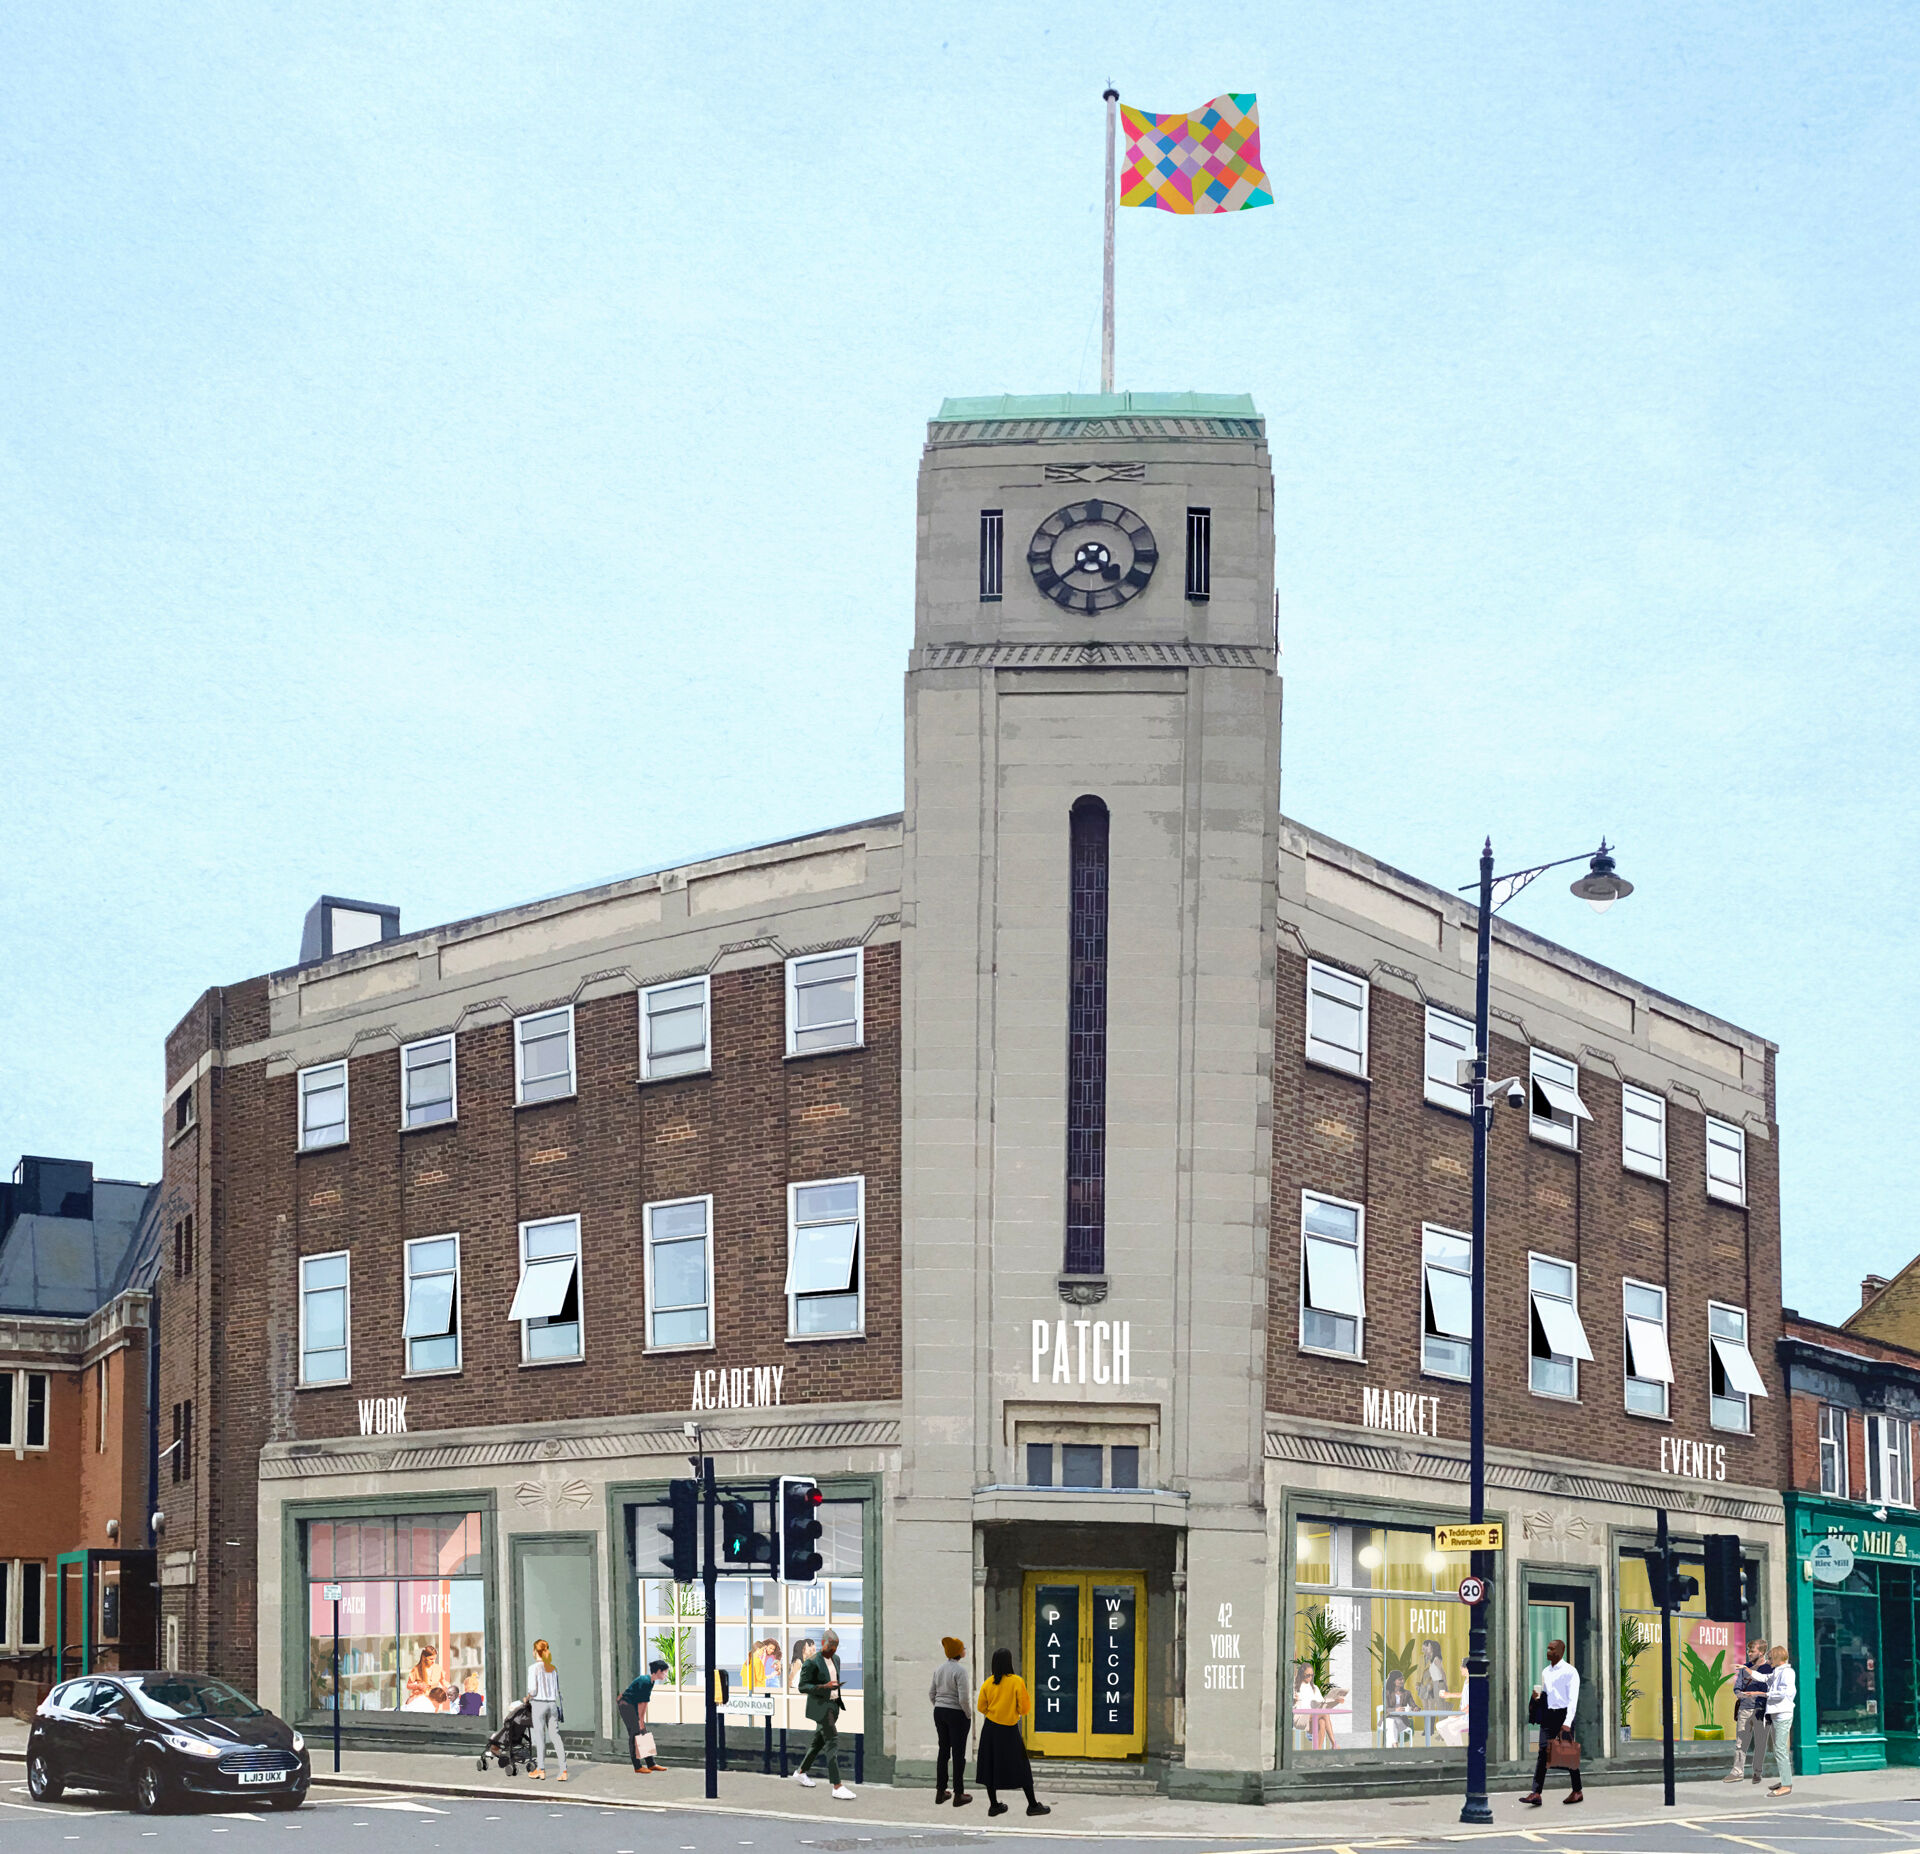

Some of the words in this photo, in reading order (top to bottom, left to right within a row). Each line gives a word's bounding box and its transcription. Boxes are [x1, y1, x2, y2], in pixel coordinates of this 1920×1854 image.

[1032, 1320, 1129, 1384] PATCH
[692, 1366, 783, 1410] ACADEMY
[359, 1397, 407, 1435] WORK
[1363, 1387, 1440, 1437] MARKET
[1661, 1437, 1726, 1481] EVENTS
[1449, 1528, 1485, 1537] Teddington
[1451, 1538, 1482, 1546] Riverside
[1861, 1530, 1890, 1556] Mill
[420, 1592, 451, 1615] PATCH
[680, 1591, 706, 1616] PATC
[787, 1588, 824, 1616] PATCH
[1463, 1585, 1480, 1597] 20
[343, 1596, 366, 1614] PATCH
[1218, 1603, 1233, 1628] 42
[1410, 1608, 1446, 1634] PATCH
[1210, 1634, 1240, 1659] YORK
[1700, 1627, 1728, 1646] PATCH
[1047, 1611, 1061, 1713] PATCH
[1106, 1599, 1120, 1722] WELCOME
[1204, 1665, 1246, 1690] STREET
[751, 1701, 773, 1709] ROAD
[244, 1773, 264, 1783] LJ13
[265, 1772, 281, 1781] UKX
